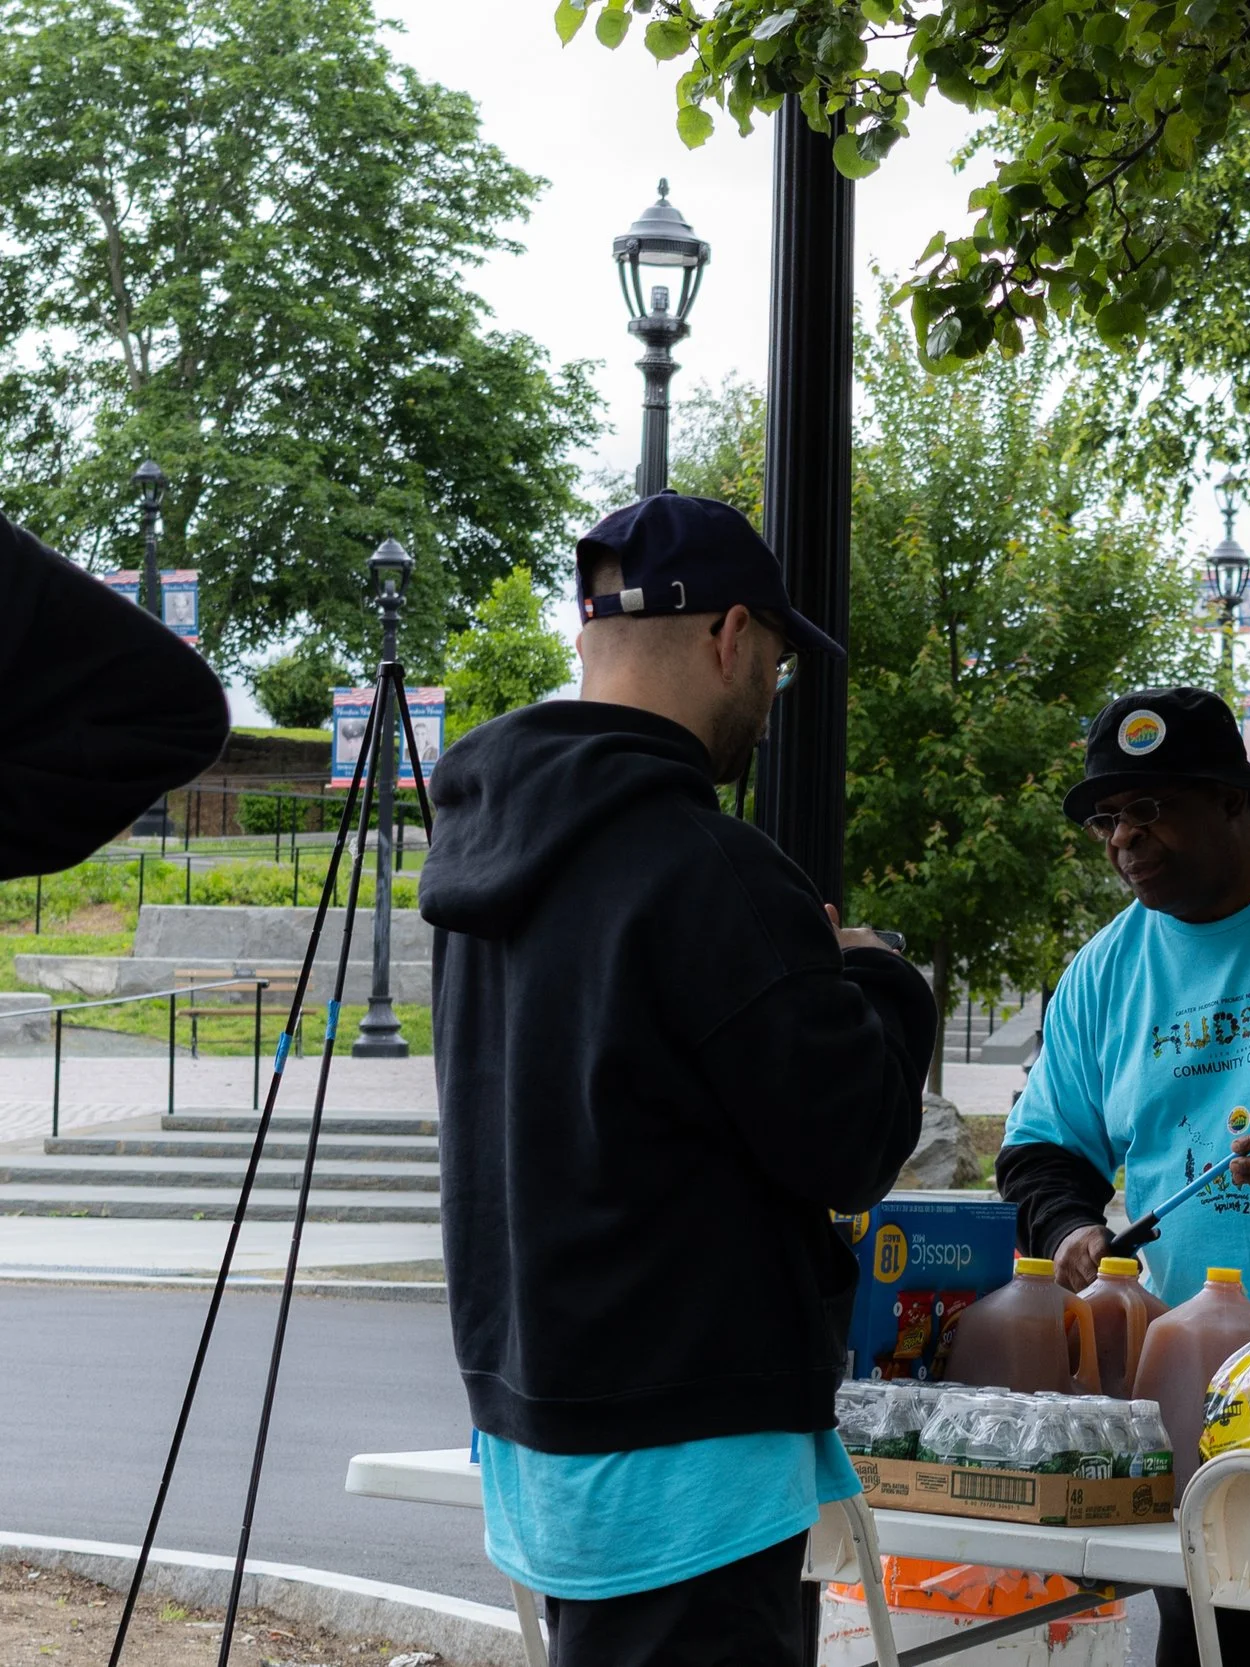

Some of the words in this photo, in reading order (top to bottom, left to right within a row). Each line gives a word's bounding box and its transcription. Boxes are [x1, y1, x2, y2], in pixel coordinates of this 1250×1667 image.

[1198, 1000, 1219, 1011] HUDSON
[1173, 1056, 1244, 1078] COMMUNITY
[911, 1234, 926, 1243] MIX
[880, 1244, 900, 1274] 18
[911, 1243, 972, 1272] classic
[1070, 1488, 1083, 1505] 48
